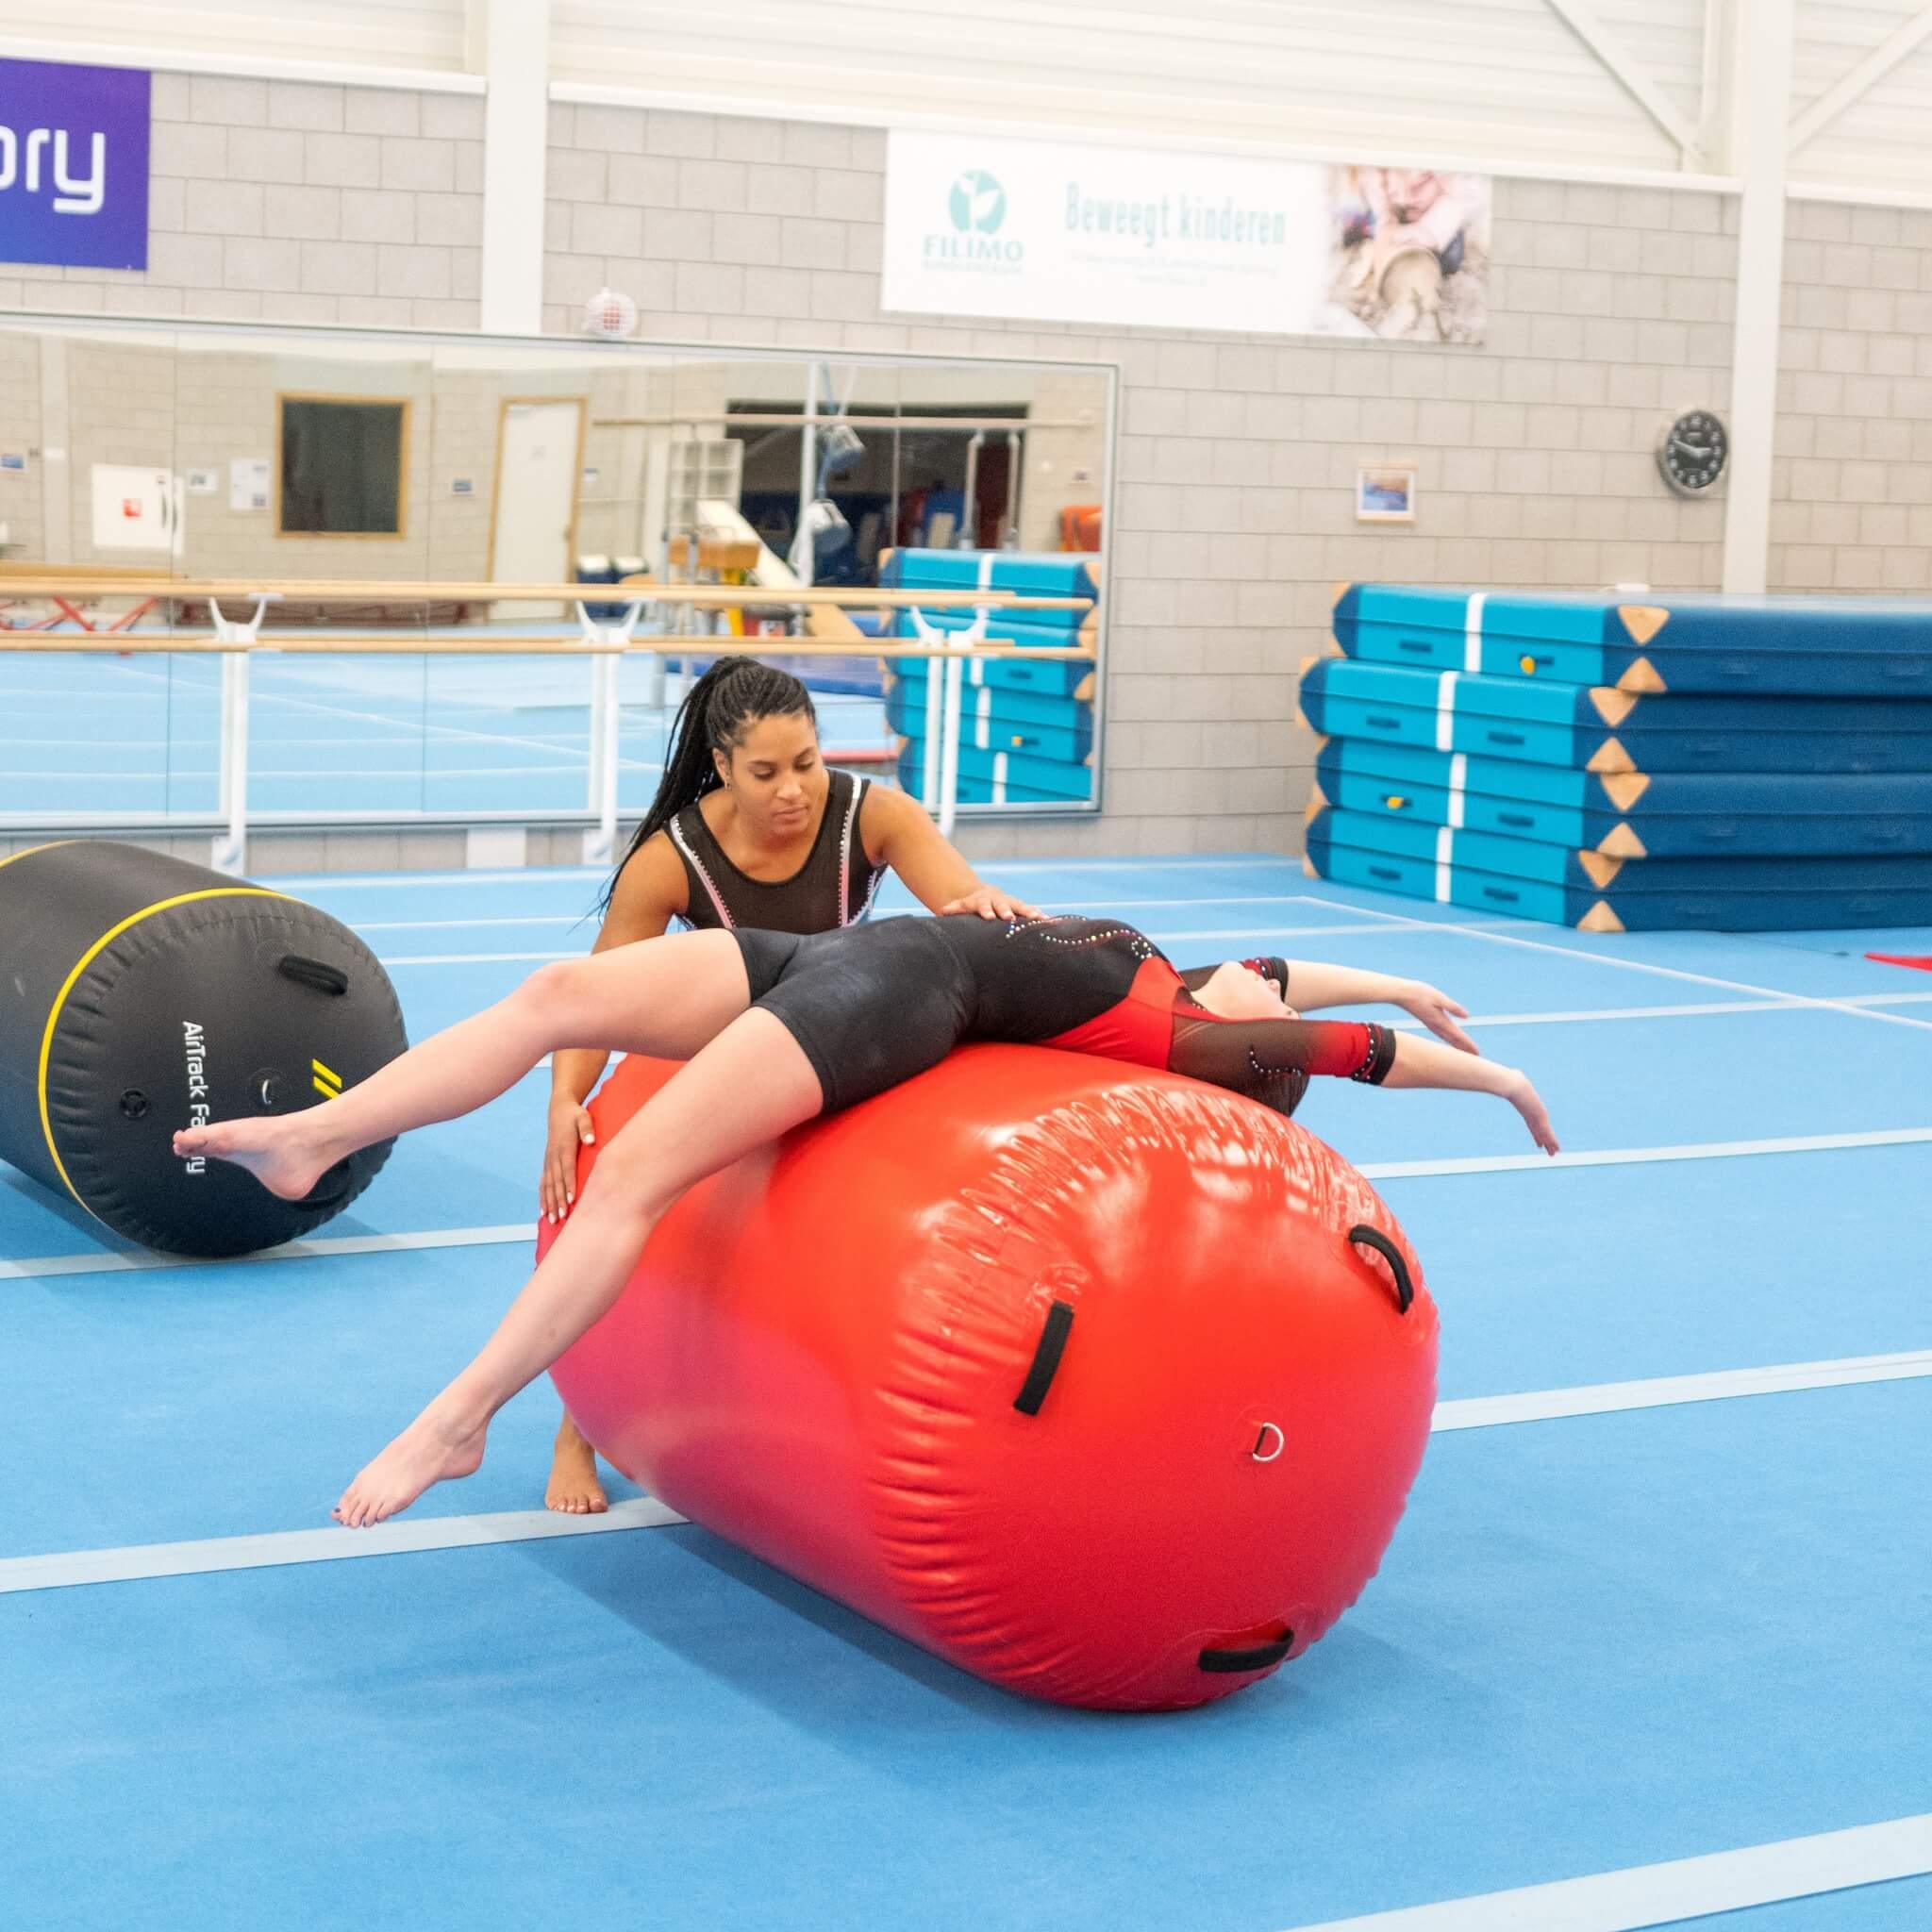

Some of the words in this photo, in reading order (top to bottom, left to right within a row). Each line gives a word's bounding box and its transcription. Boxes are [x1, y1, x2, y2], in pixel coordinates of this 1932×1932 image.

[923, 233, 1024, 262] FILIMO
[1065, 180, 1170, 249] Beweegt
[1178, 192, 1286, 245] kinderen
[182, 1021, 209, 1099] AirTrack
[186, 1104, 210, 1174] Fary
